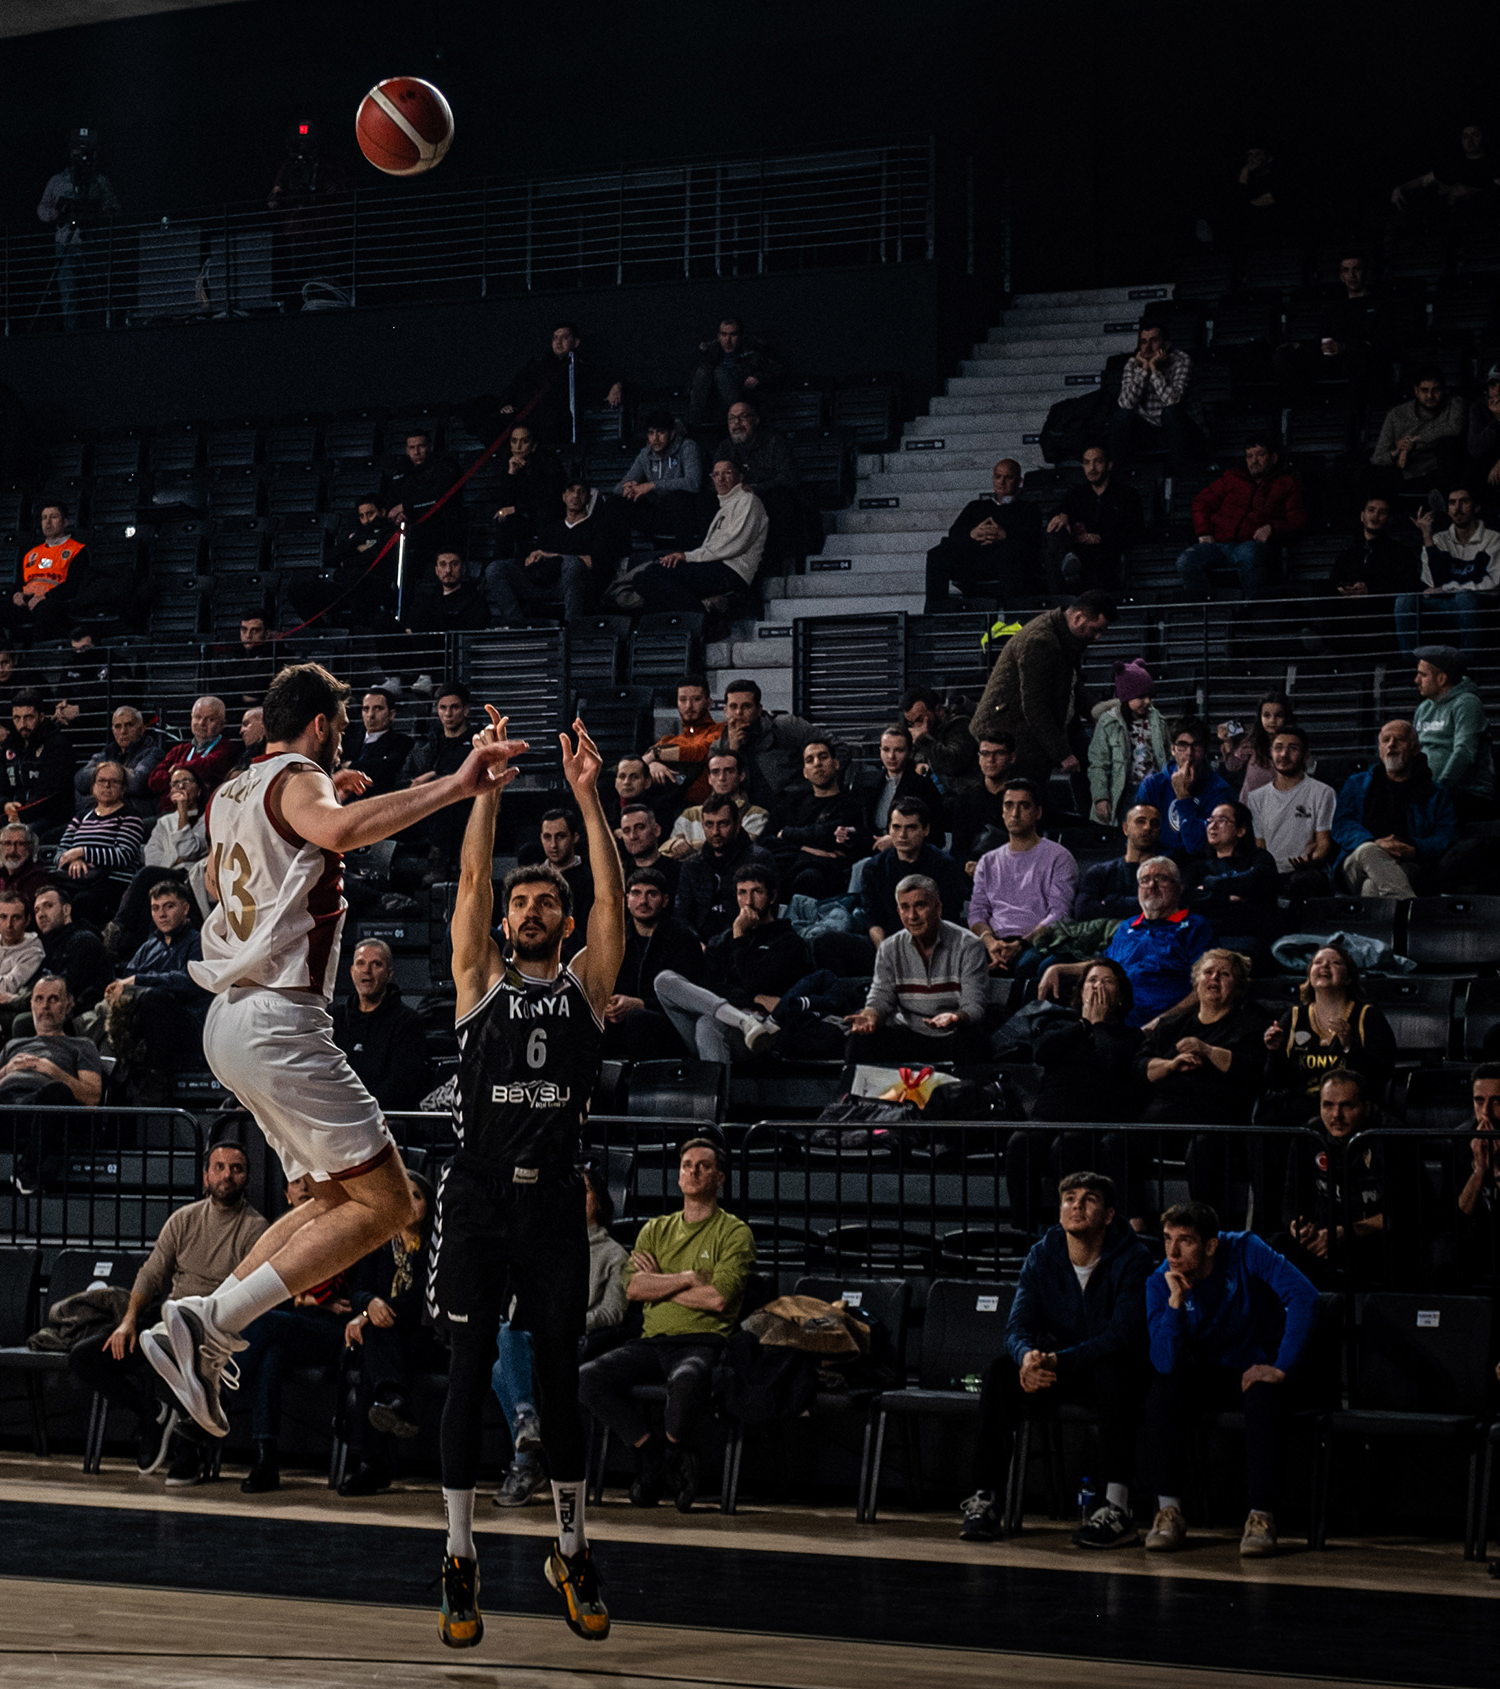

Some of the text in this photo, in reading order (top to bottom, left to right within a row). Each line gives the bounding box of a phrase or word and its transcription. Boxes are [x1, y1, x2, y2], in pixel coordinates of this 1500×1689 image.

[214, 842, 257, 942] 13
[509, 995, 570, 1019] KONYA
[526, 1027, 548, 1069] 6
[107, 1163, 118, 1174] 02
